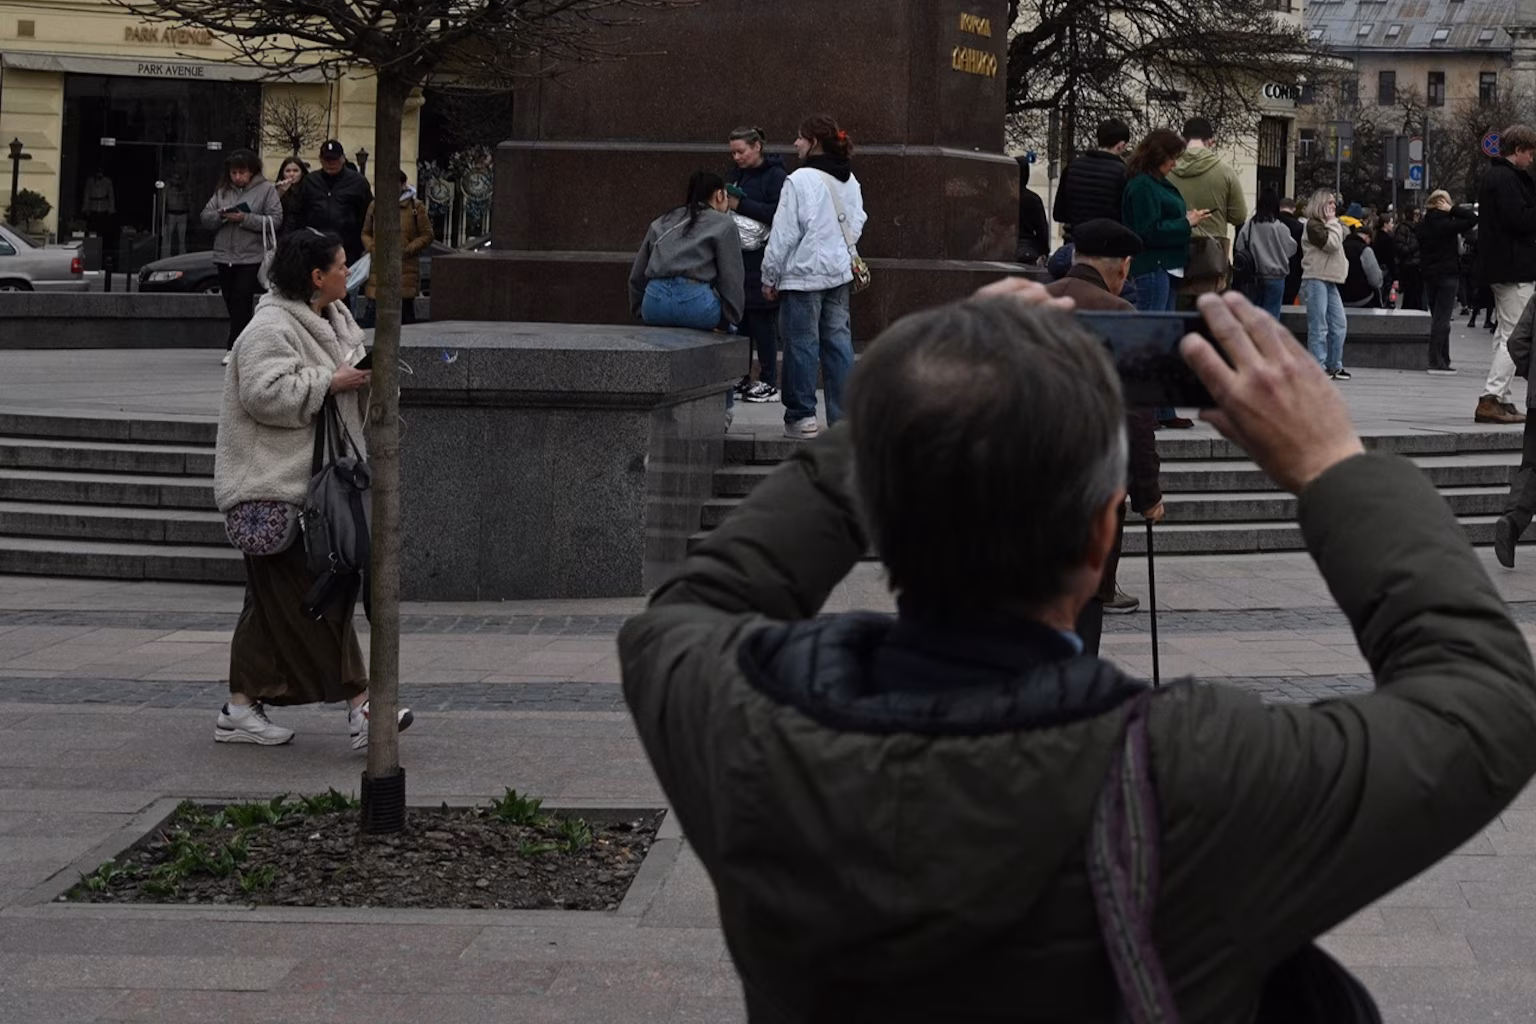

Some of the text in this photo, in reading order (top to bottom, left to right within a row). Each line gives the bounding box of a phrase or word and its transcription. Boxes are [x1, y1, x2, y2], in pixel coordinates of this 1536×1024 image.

[124, 26, 212, 46] PARK AVENUE
[138, 63, 205, 77] PARK AVENUE
